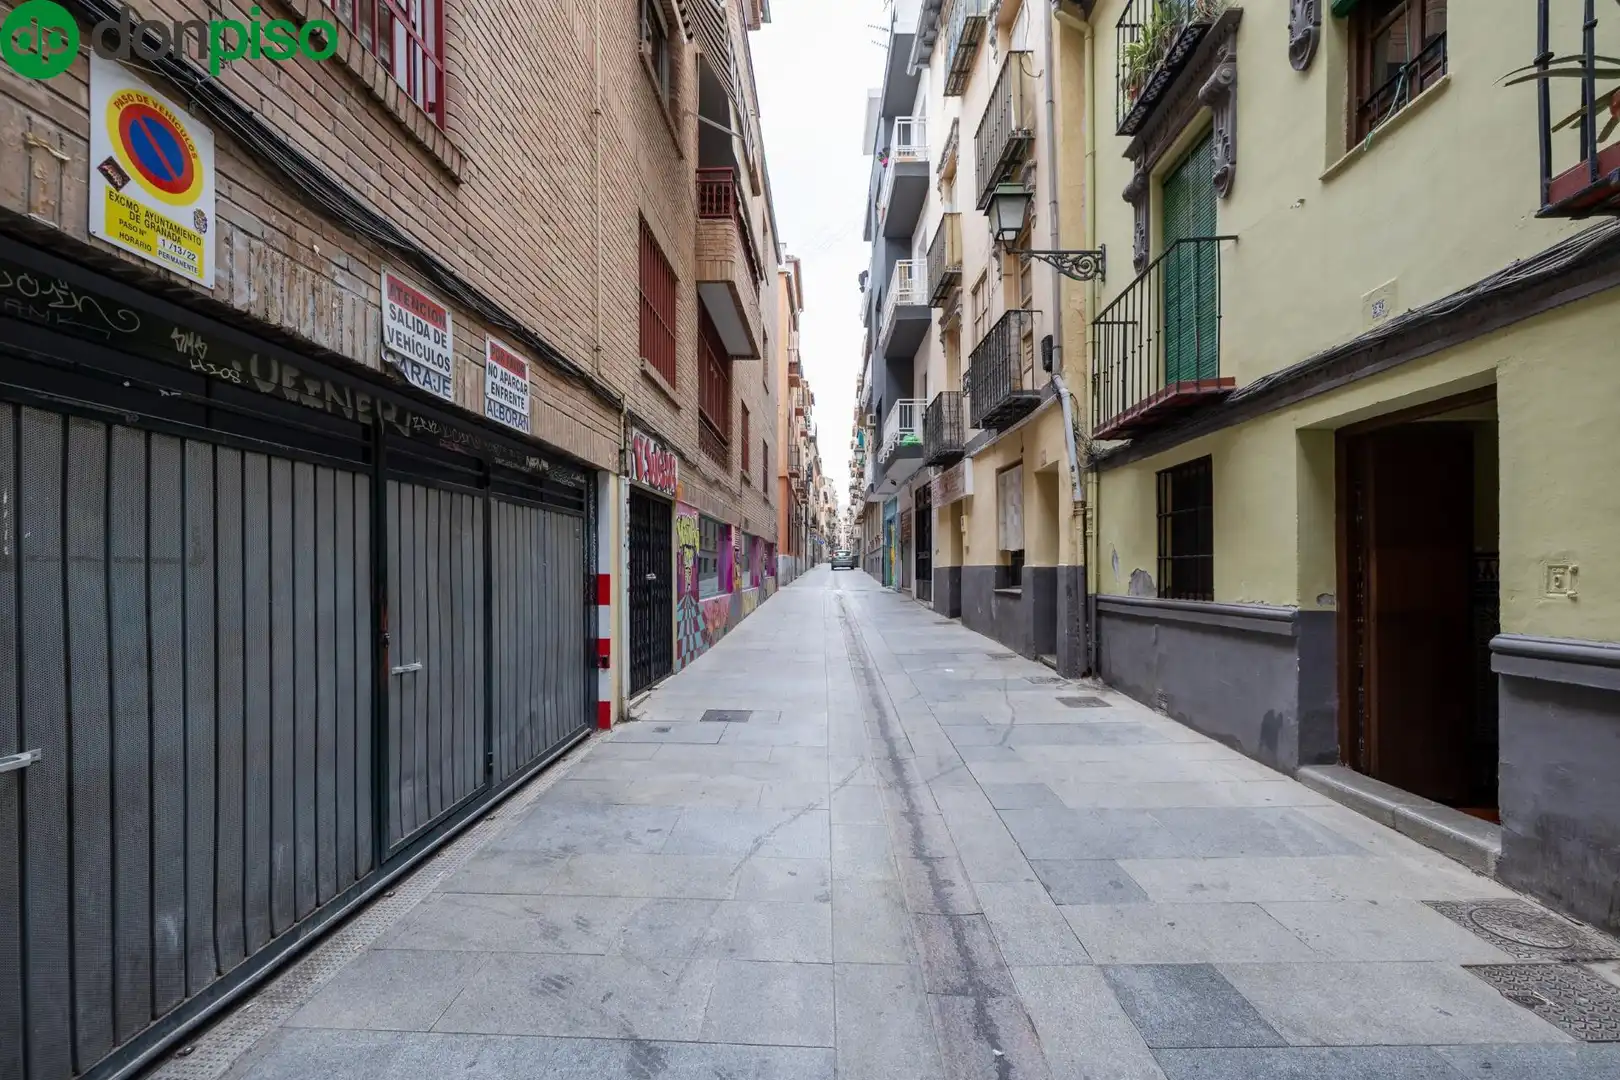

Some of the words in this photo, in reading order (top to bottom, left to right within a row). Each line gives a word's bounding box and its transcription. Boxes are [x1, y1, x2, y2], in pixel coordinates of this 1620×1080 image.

[113, 93, 134, 111] PASO
[135, 93, 149, 105] DE
[108, 190, 141, 216] EXCMO.
[144, 209, 202, 246] AYUNTAMIENTO
[118, 217, 138, 233] PASO
[129, 211, 141, 224] DE
[144, 219, 182, 246] GRANADA
[119, 231, 152, 253] HORARIO
[158, 249, 198, 274] PERMANENTE
[389, 303, 431, 341] SALIDA
[433, 330, 448, 350] DE
[386, 324, 451, 373] VEHÍCULOS
[488, 361, 498, 379] NO
[500, 368, 528, 396] APARCAR
[490, 381, 525, 410] ENFRENTE
[486, 400, 529, 432] ALBORAN
